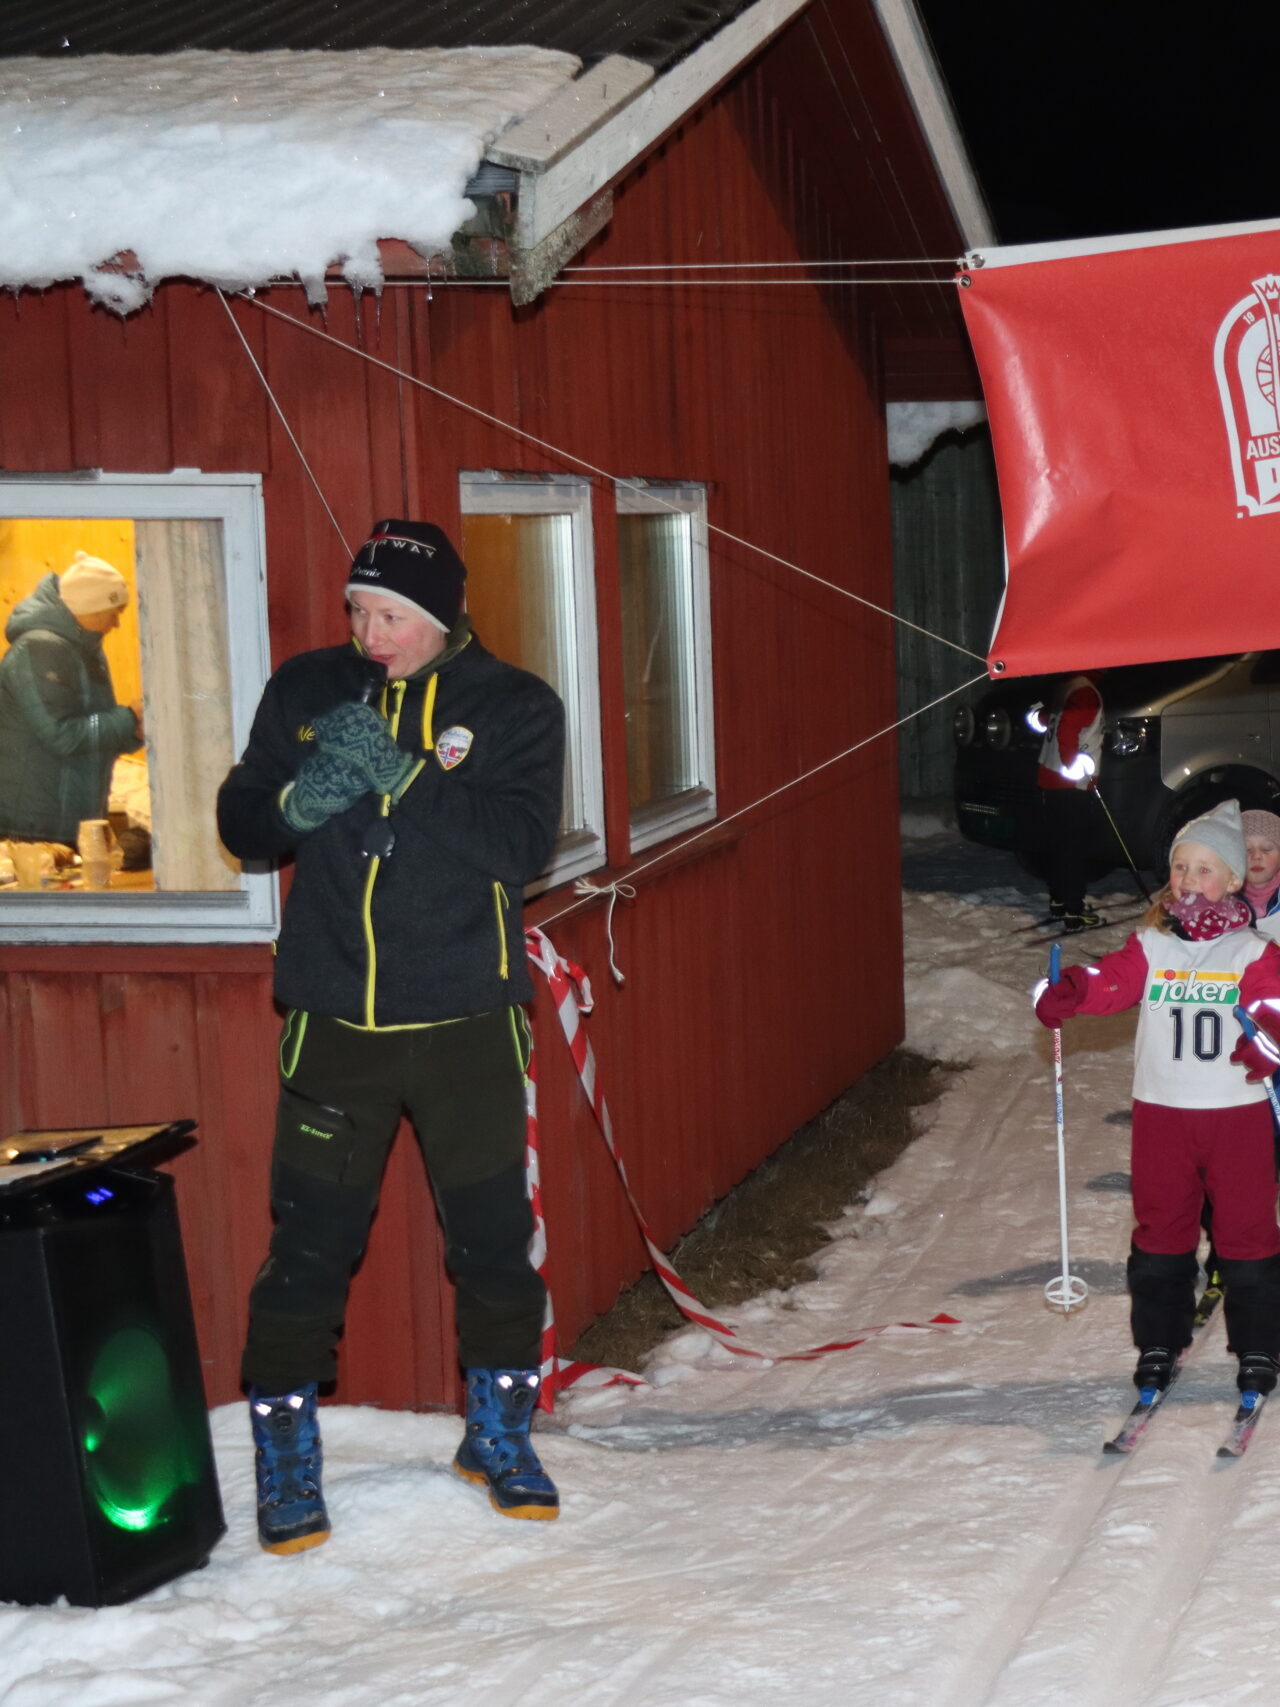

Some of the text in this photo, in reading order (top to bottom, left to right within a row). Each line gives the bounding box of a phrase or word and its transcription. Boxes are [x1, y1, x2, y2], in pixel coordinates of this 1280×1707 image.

[1242, 311, 1256, 325] 19
[1150, 969, 1237, 1011] joker
[1170, 1007, 1222, 1062] 10
